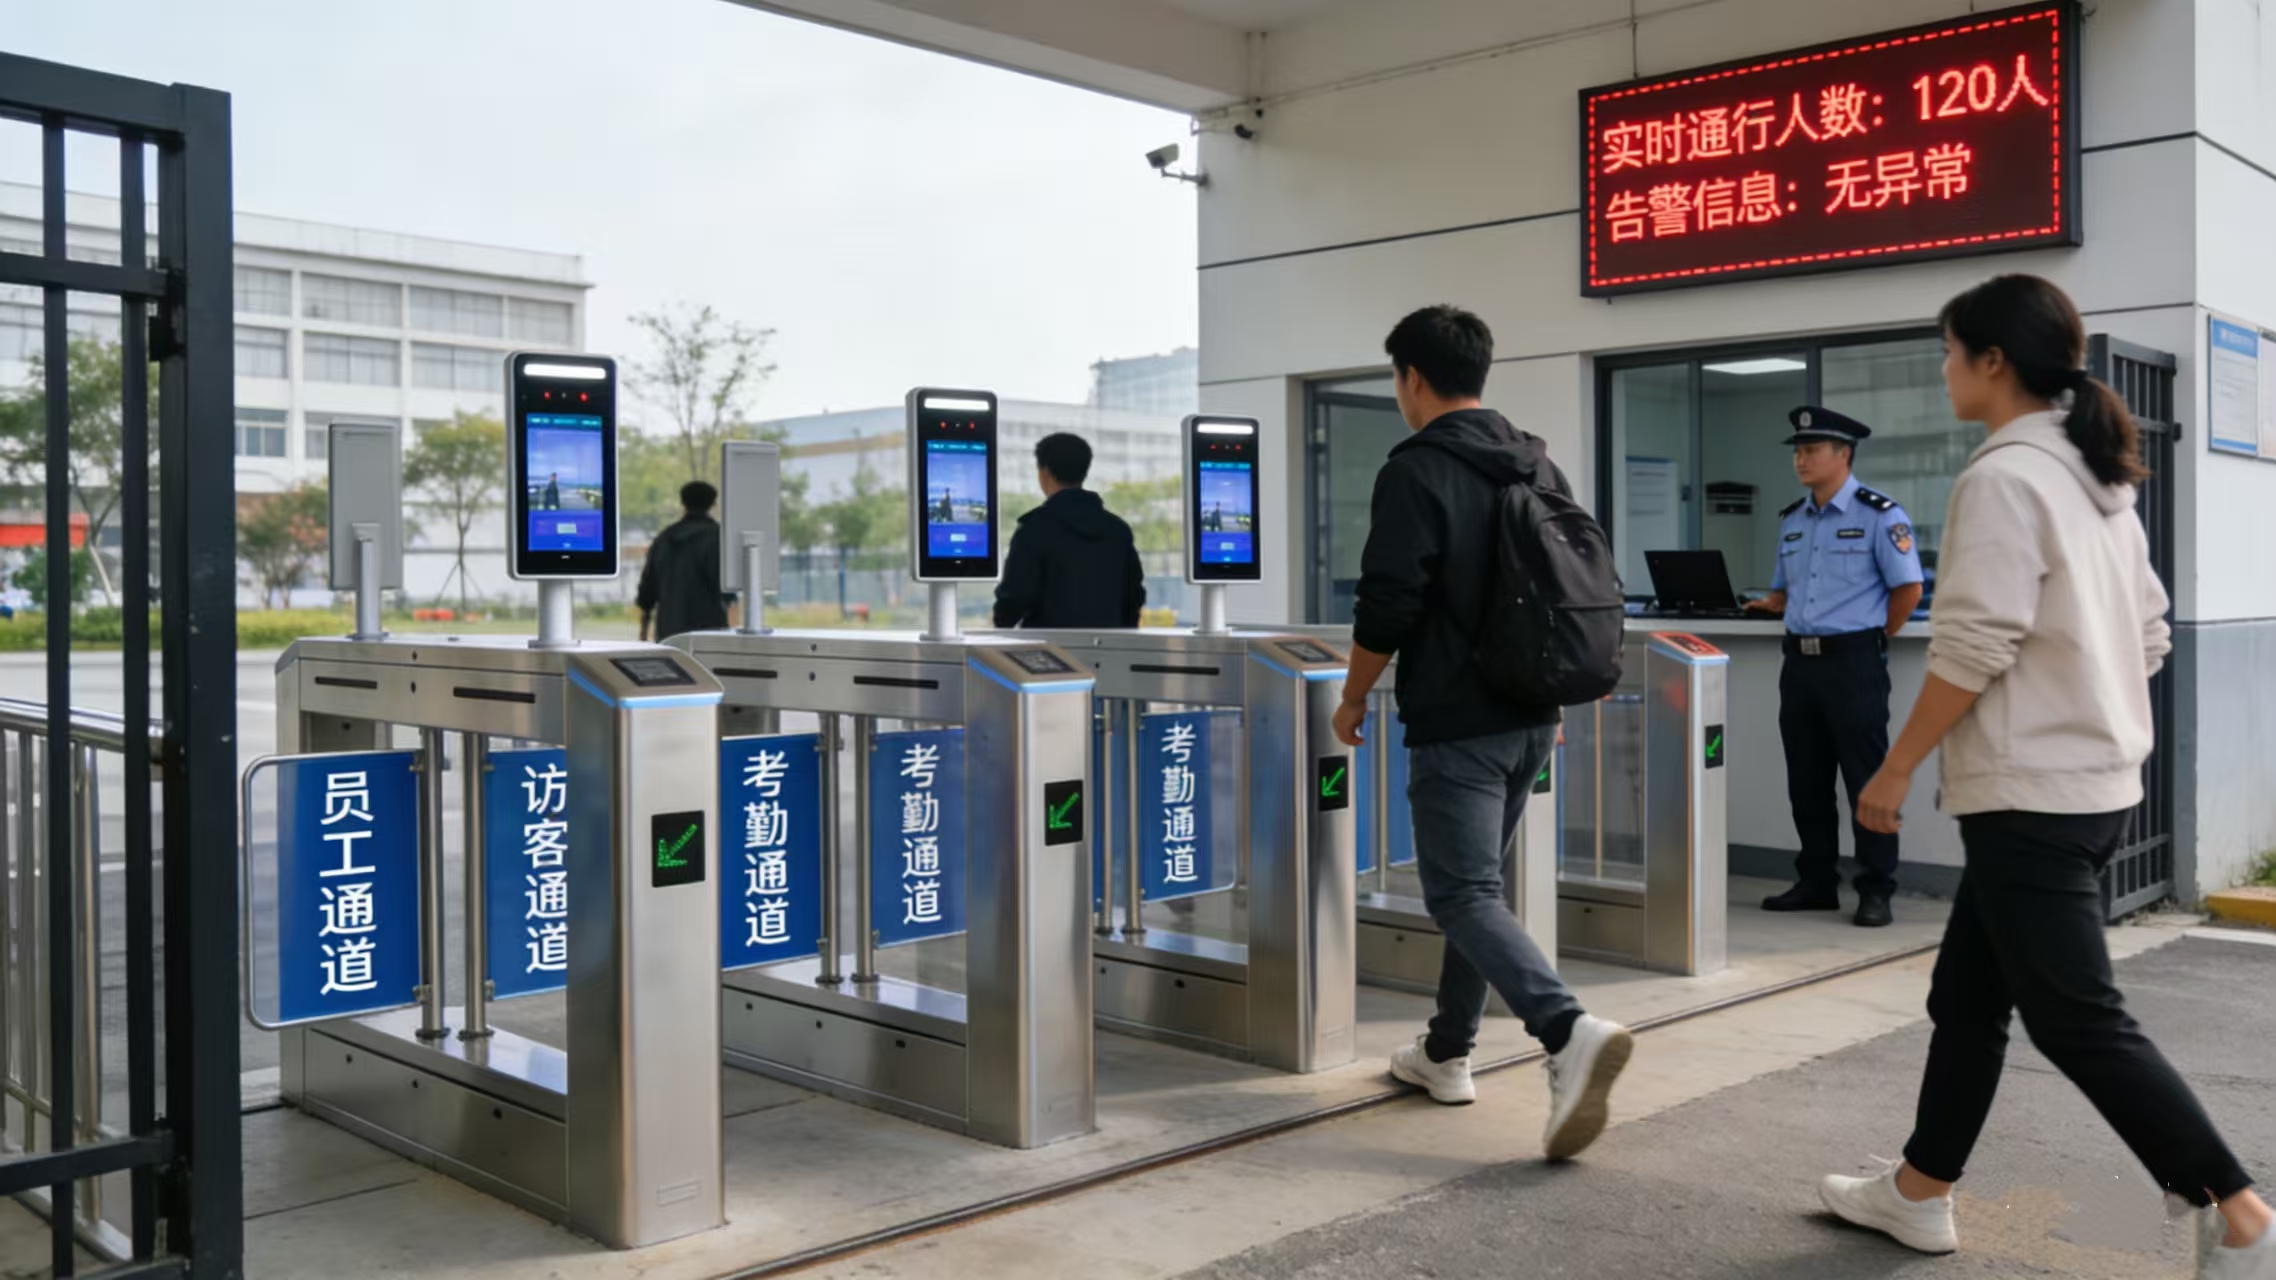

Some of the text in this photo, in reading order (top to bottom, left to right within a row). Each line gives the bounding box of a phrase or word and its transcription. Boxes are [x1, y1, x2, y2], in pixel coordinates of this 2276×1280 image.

[319, 771, 378, 995] 员工通道
[521, 763, 568, 974] 访客通道
[742, 749, 790, 947] 考勤通道
[900, 743, 942, 925] 考勤通道
[1161, 720, 1199, 884] 考勤通道
